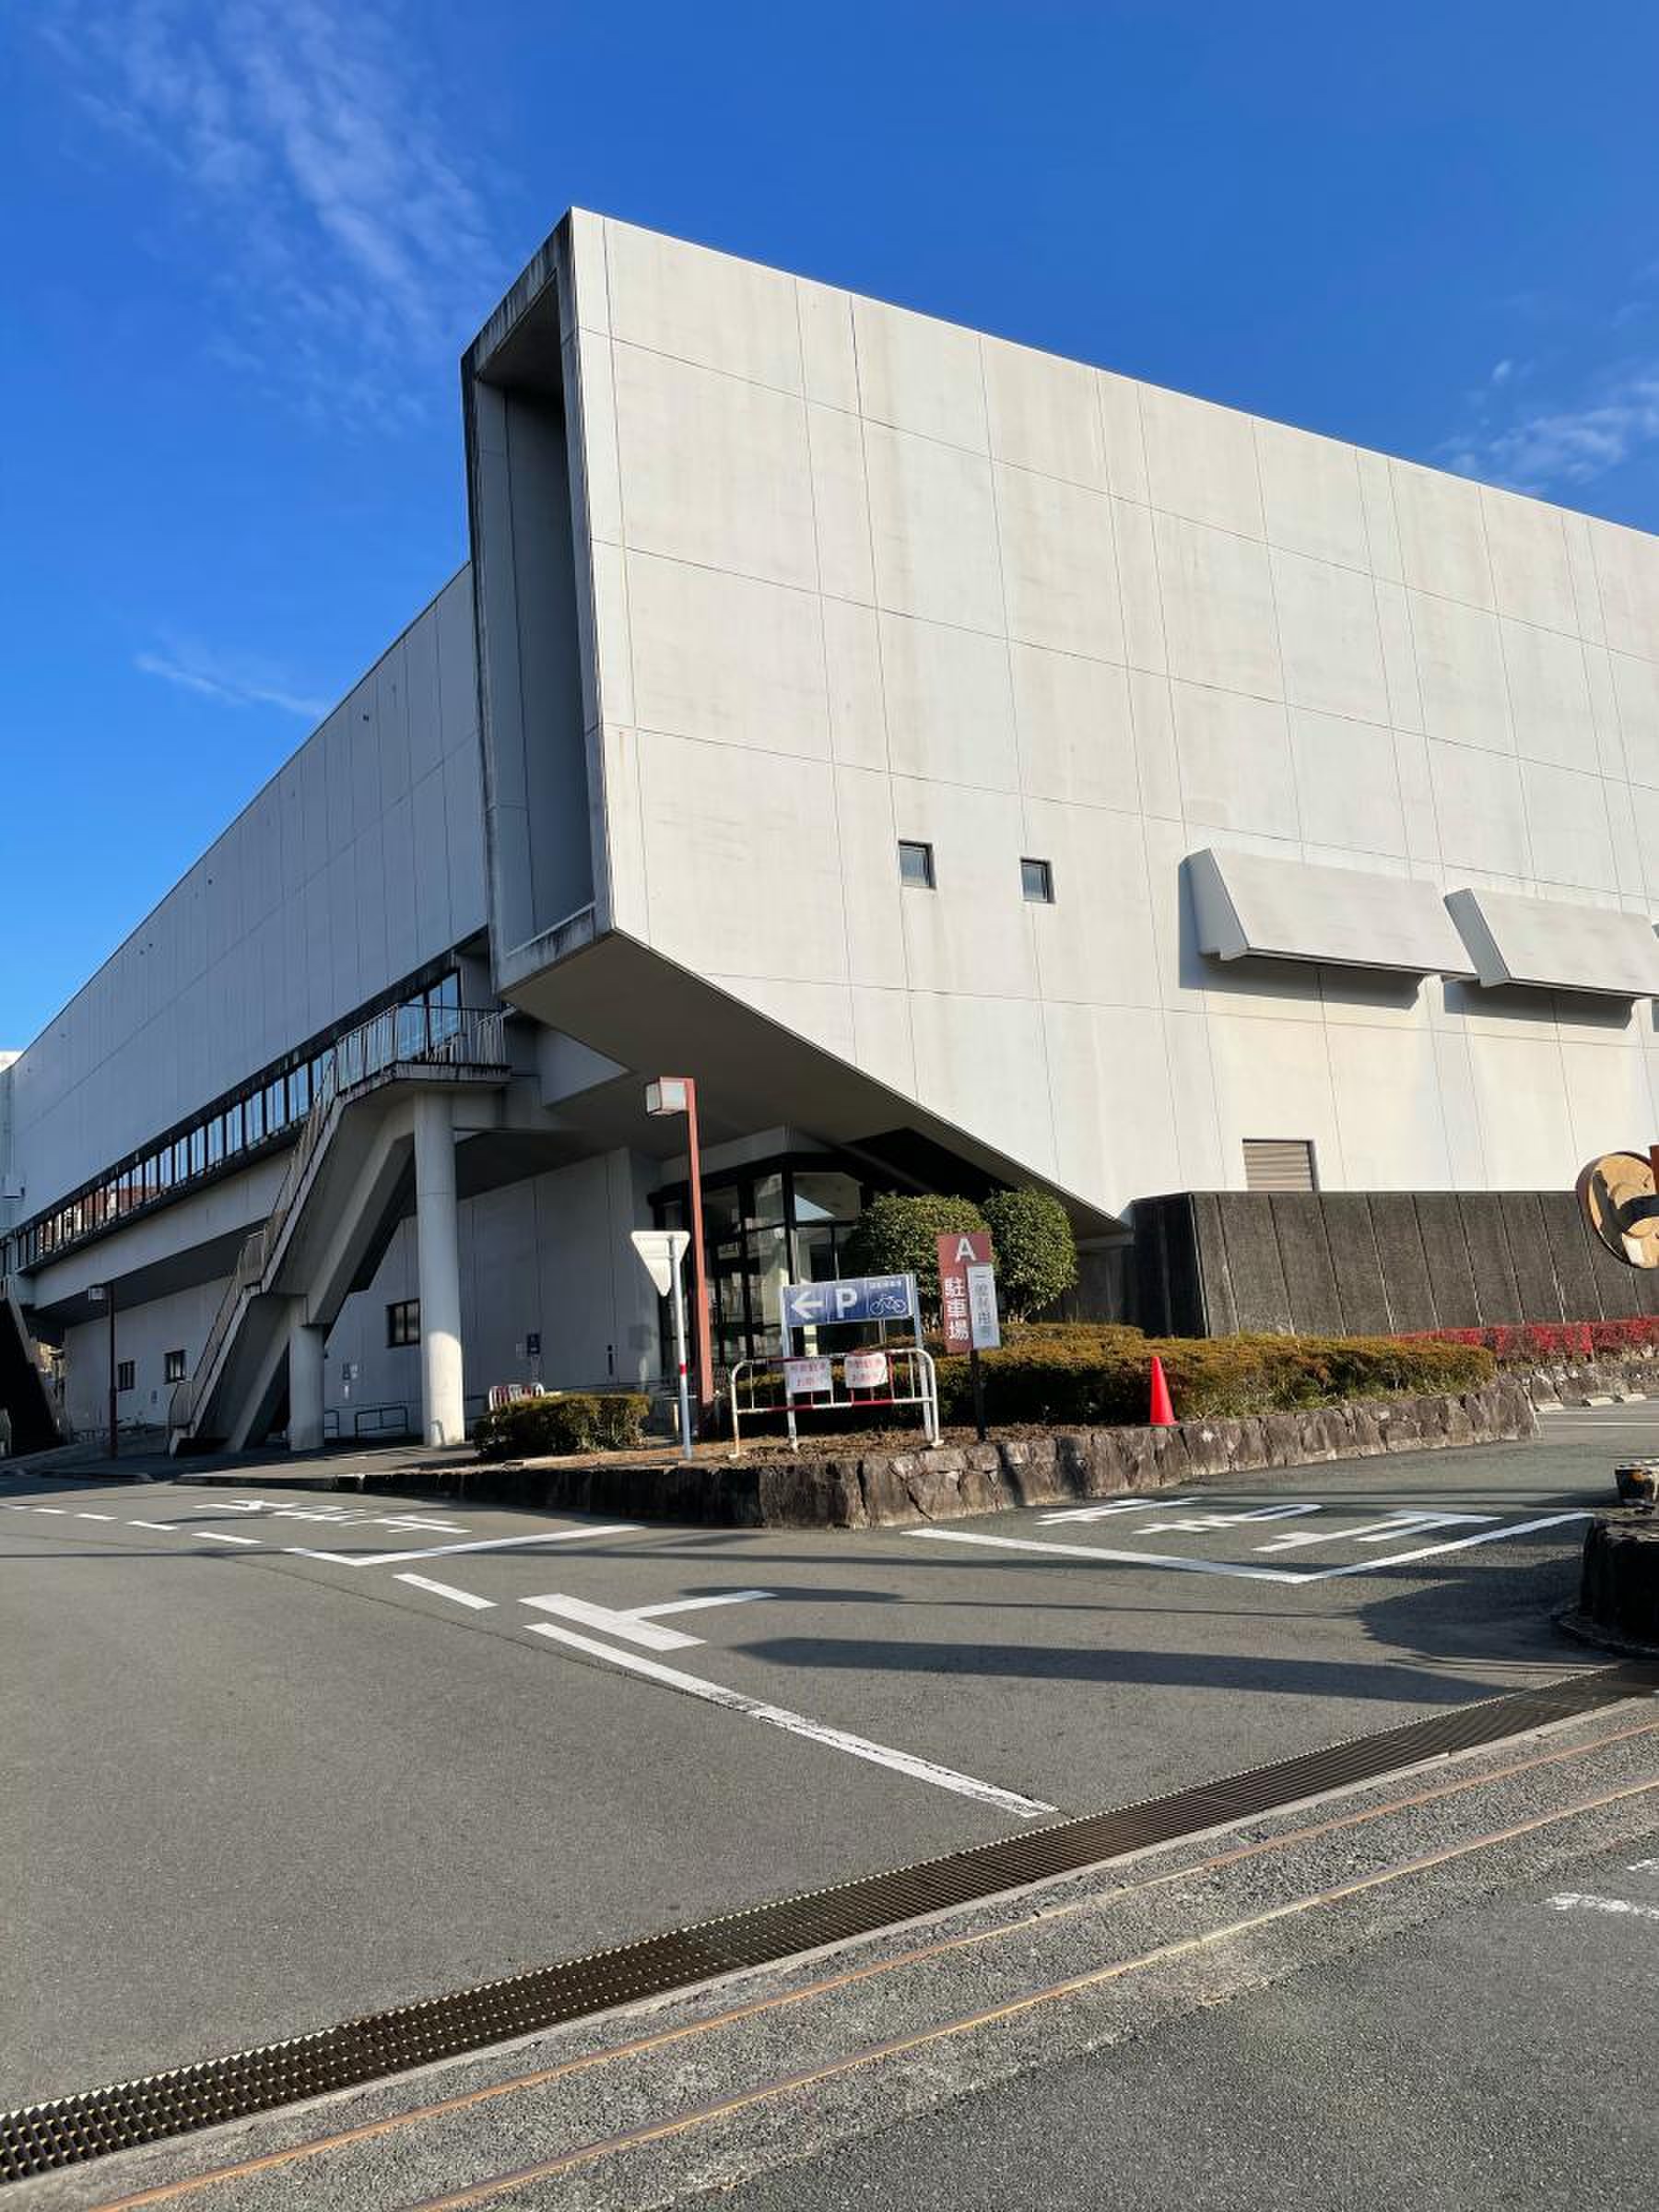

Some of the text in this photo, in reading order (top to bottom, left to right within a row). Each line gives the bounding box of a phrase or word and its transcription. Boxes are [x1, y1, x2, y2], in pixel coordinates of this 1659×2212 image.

[955, 1238, 976, 1262] A
[835, 1288, 858, 1319] P
[944, 1276, 970, 1340] 駐車場
